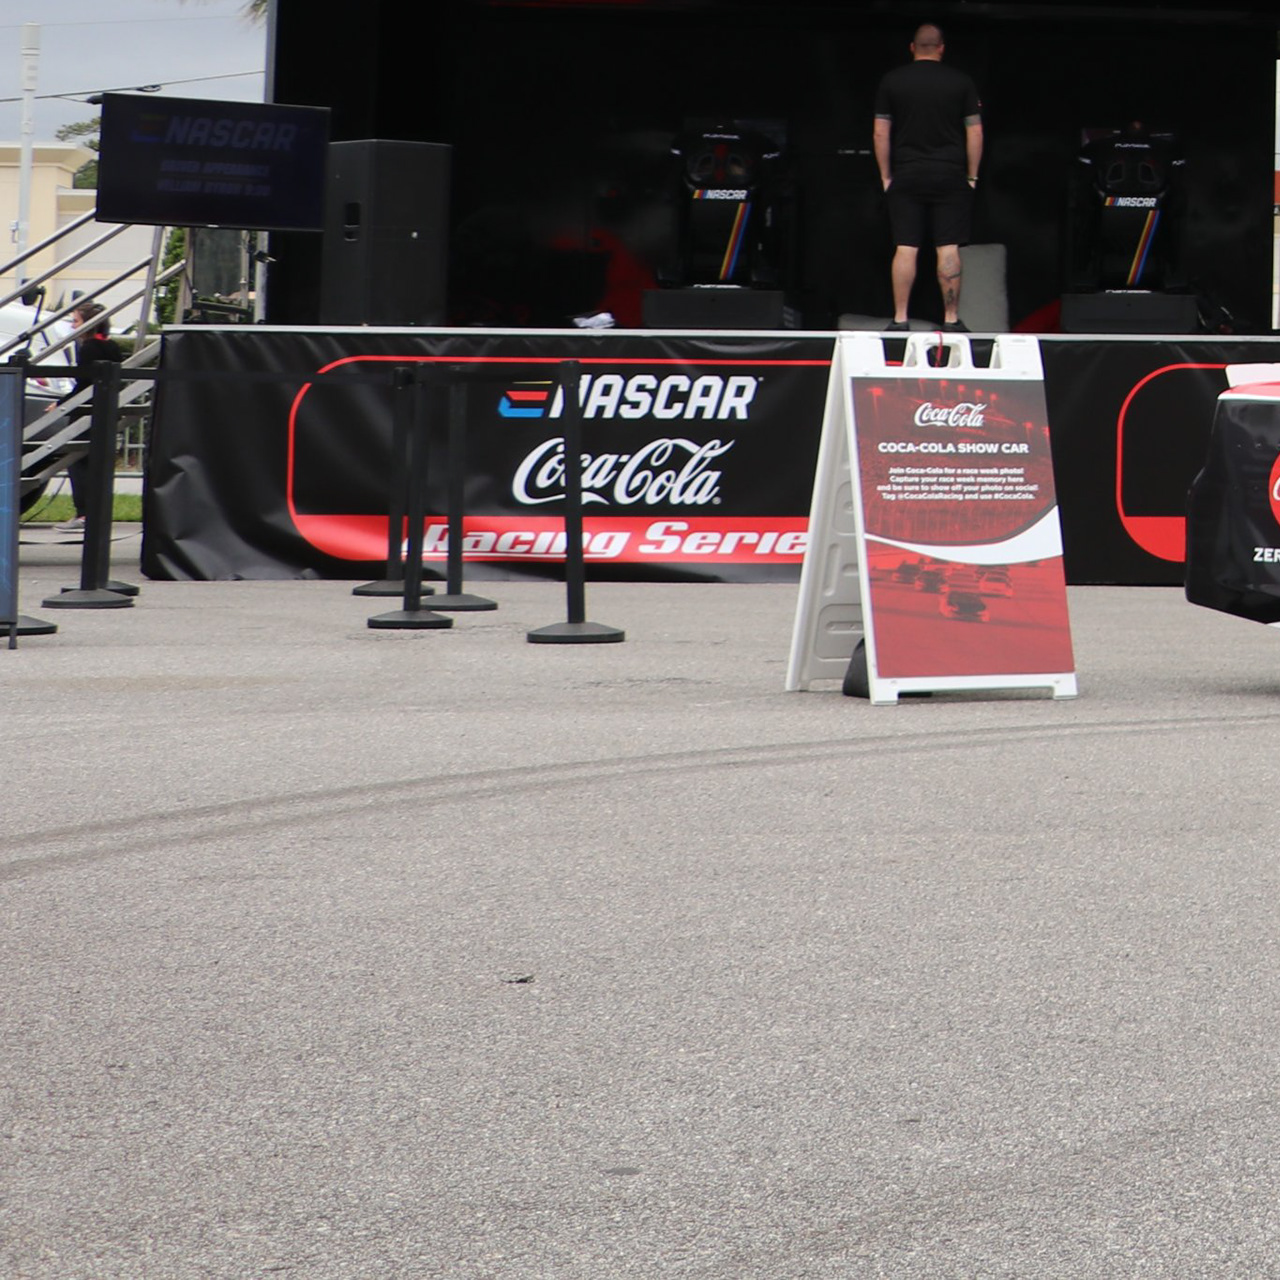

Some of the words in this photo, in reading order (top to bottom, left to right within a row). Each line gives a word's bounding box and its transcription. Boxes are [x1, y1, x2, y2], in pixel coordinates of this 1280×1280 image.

[877, 442, 956, 454] COCA-COLA
[958, 443, 999, 454] SHOW
[1001, 443, 1030, 454] CAR
[639, 521, 809, 555] Serie
